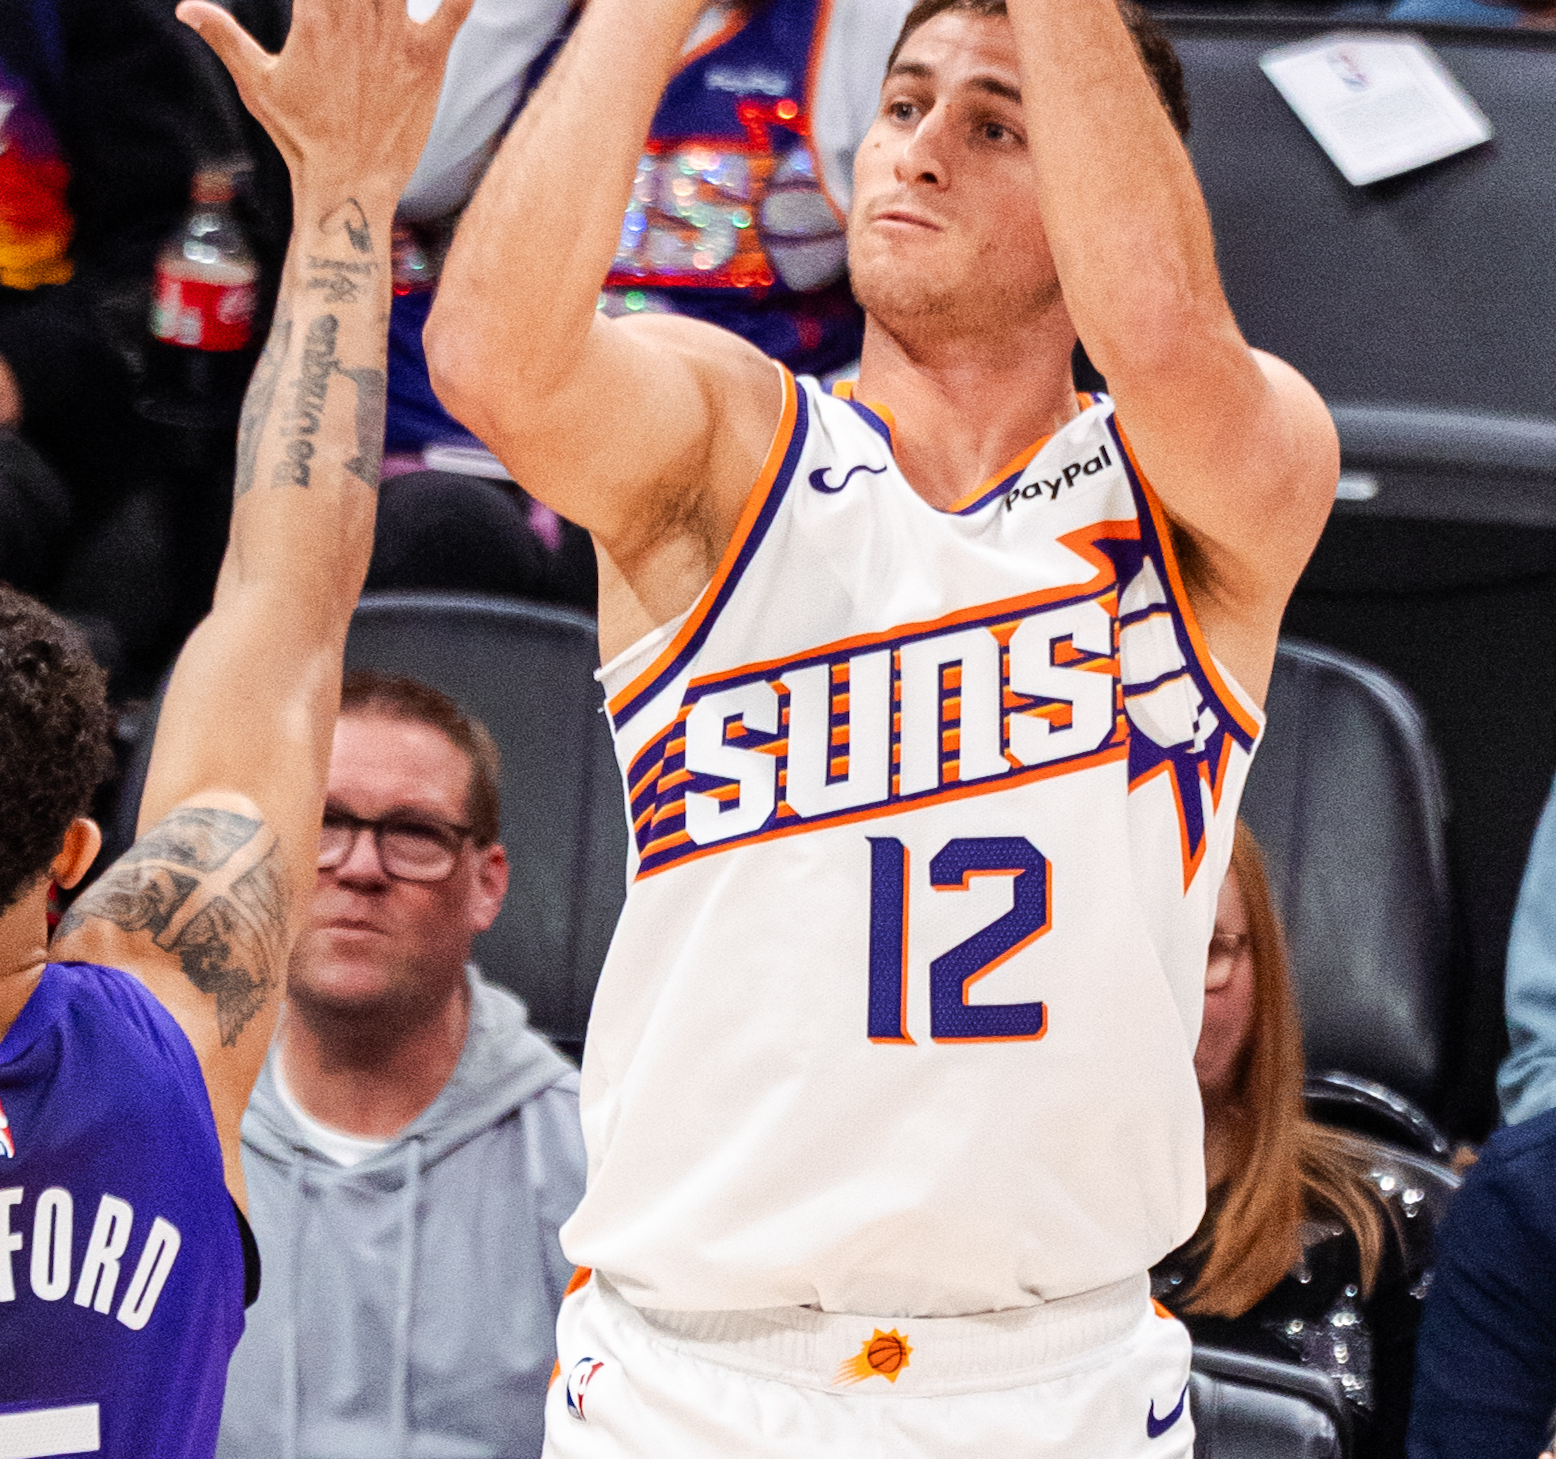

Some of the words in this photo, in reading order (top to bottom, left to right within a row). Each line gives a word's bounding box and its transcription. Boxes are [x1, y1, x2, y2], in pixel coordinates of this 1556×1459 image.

[1004, 444, 1114, 513] PayPal
[684, 593, 1120, 846] SUNS
[866, 835, 1052, 1045] 12
